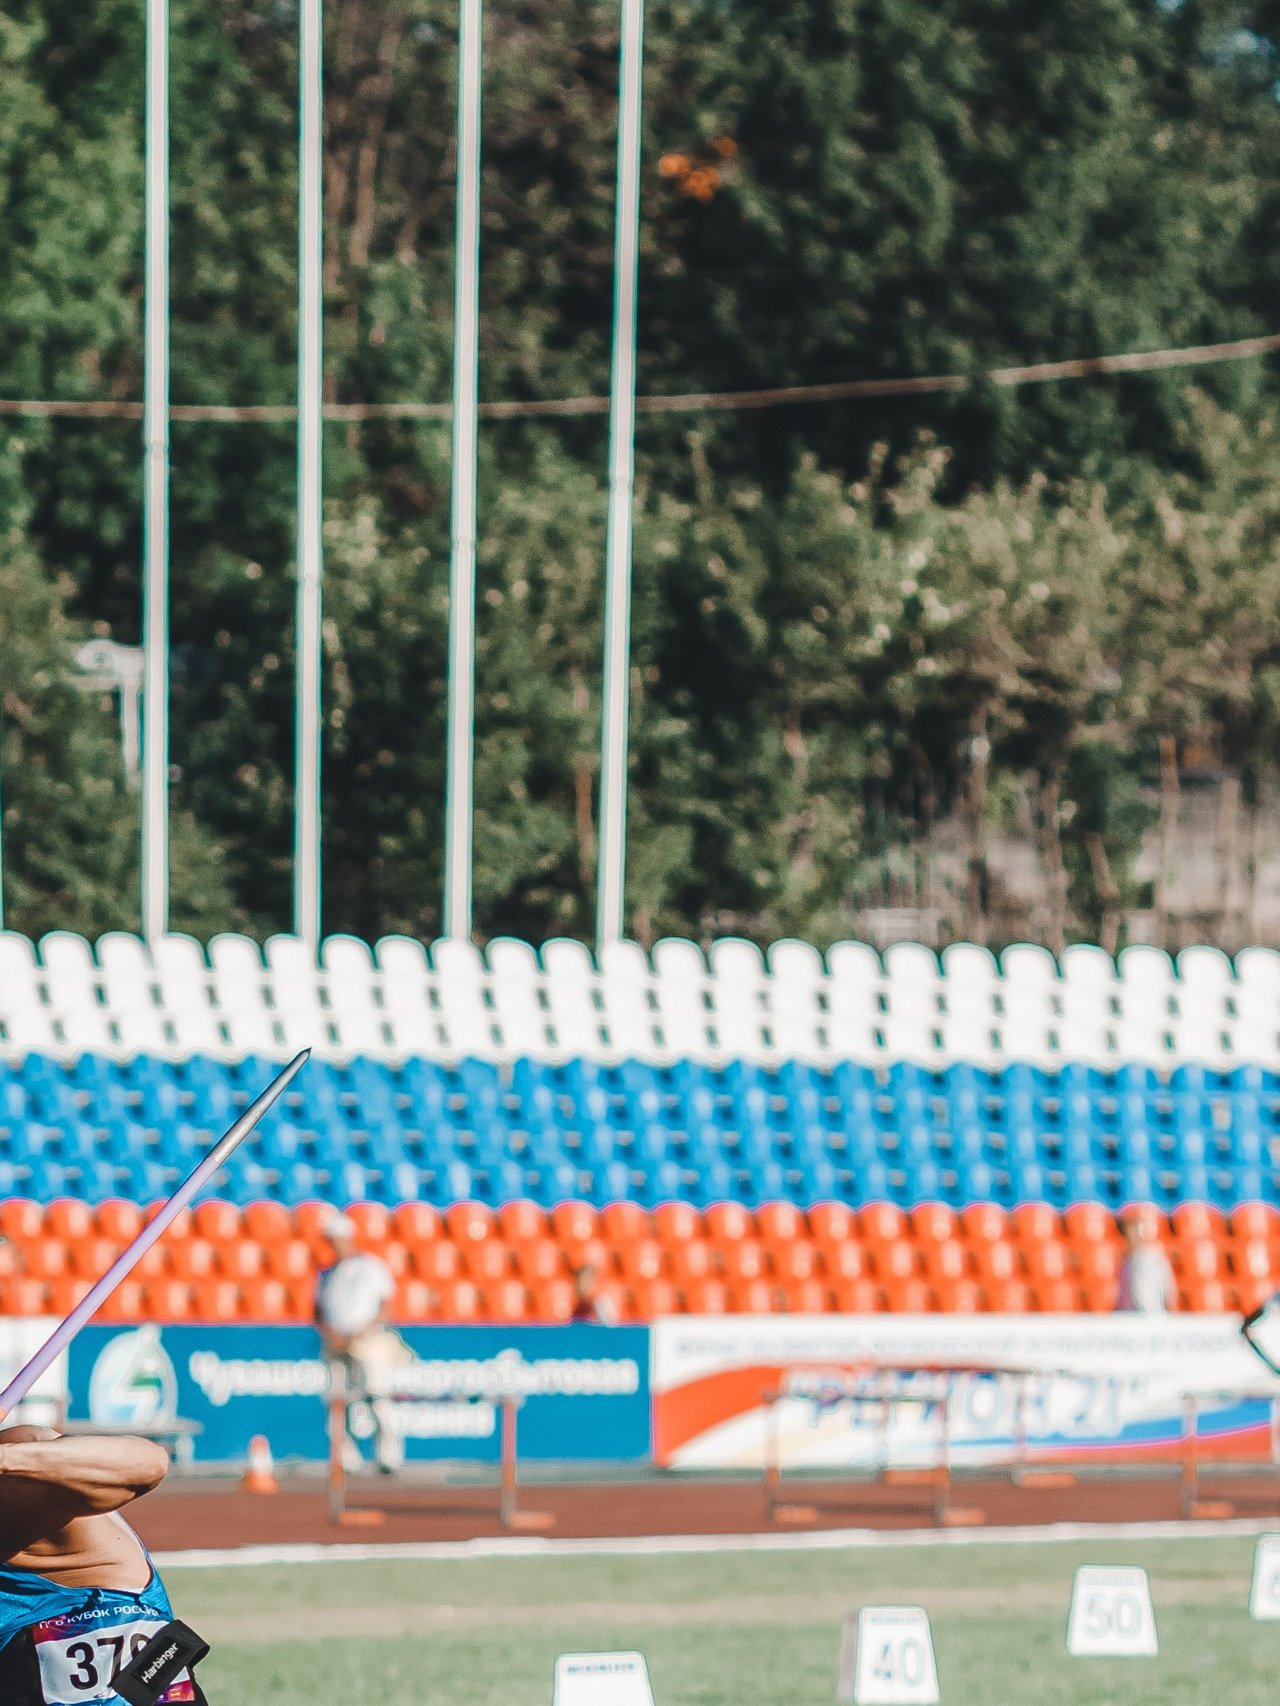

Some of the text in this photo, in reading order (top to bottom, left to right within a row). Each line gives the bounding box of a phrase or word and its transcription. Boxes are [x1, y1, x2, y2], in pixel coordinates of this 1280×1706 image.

[67, 1609, 110, 1624] КУБОК
[1083, 1593, 1141, 1638] 50
[141, 1642, 180, 1684] Harbinger
[871, 1639, 924, 1687] 40
